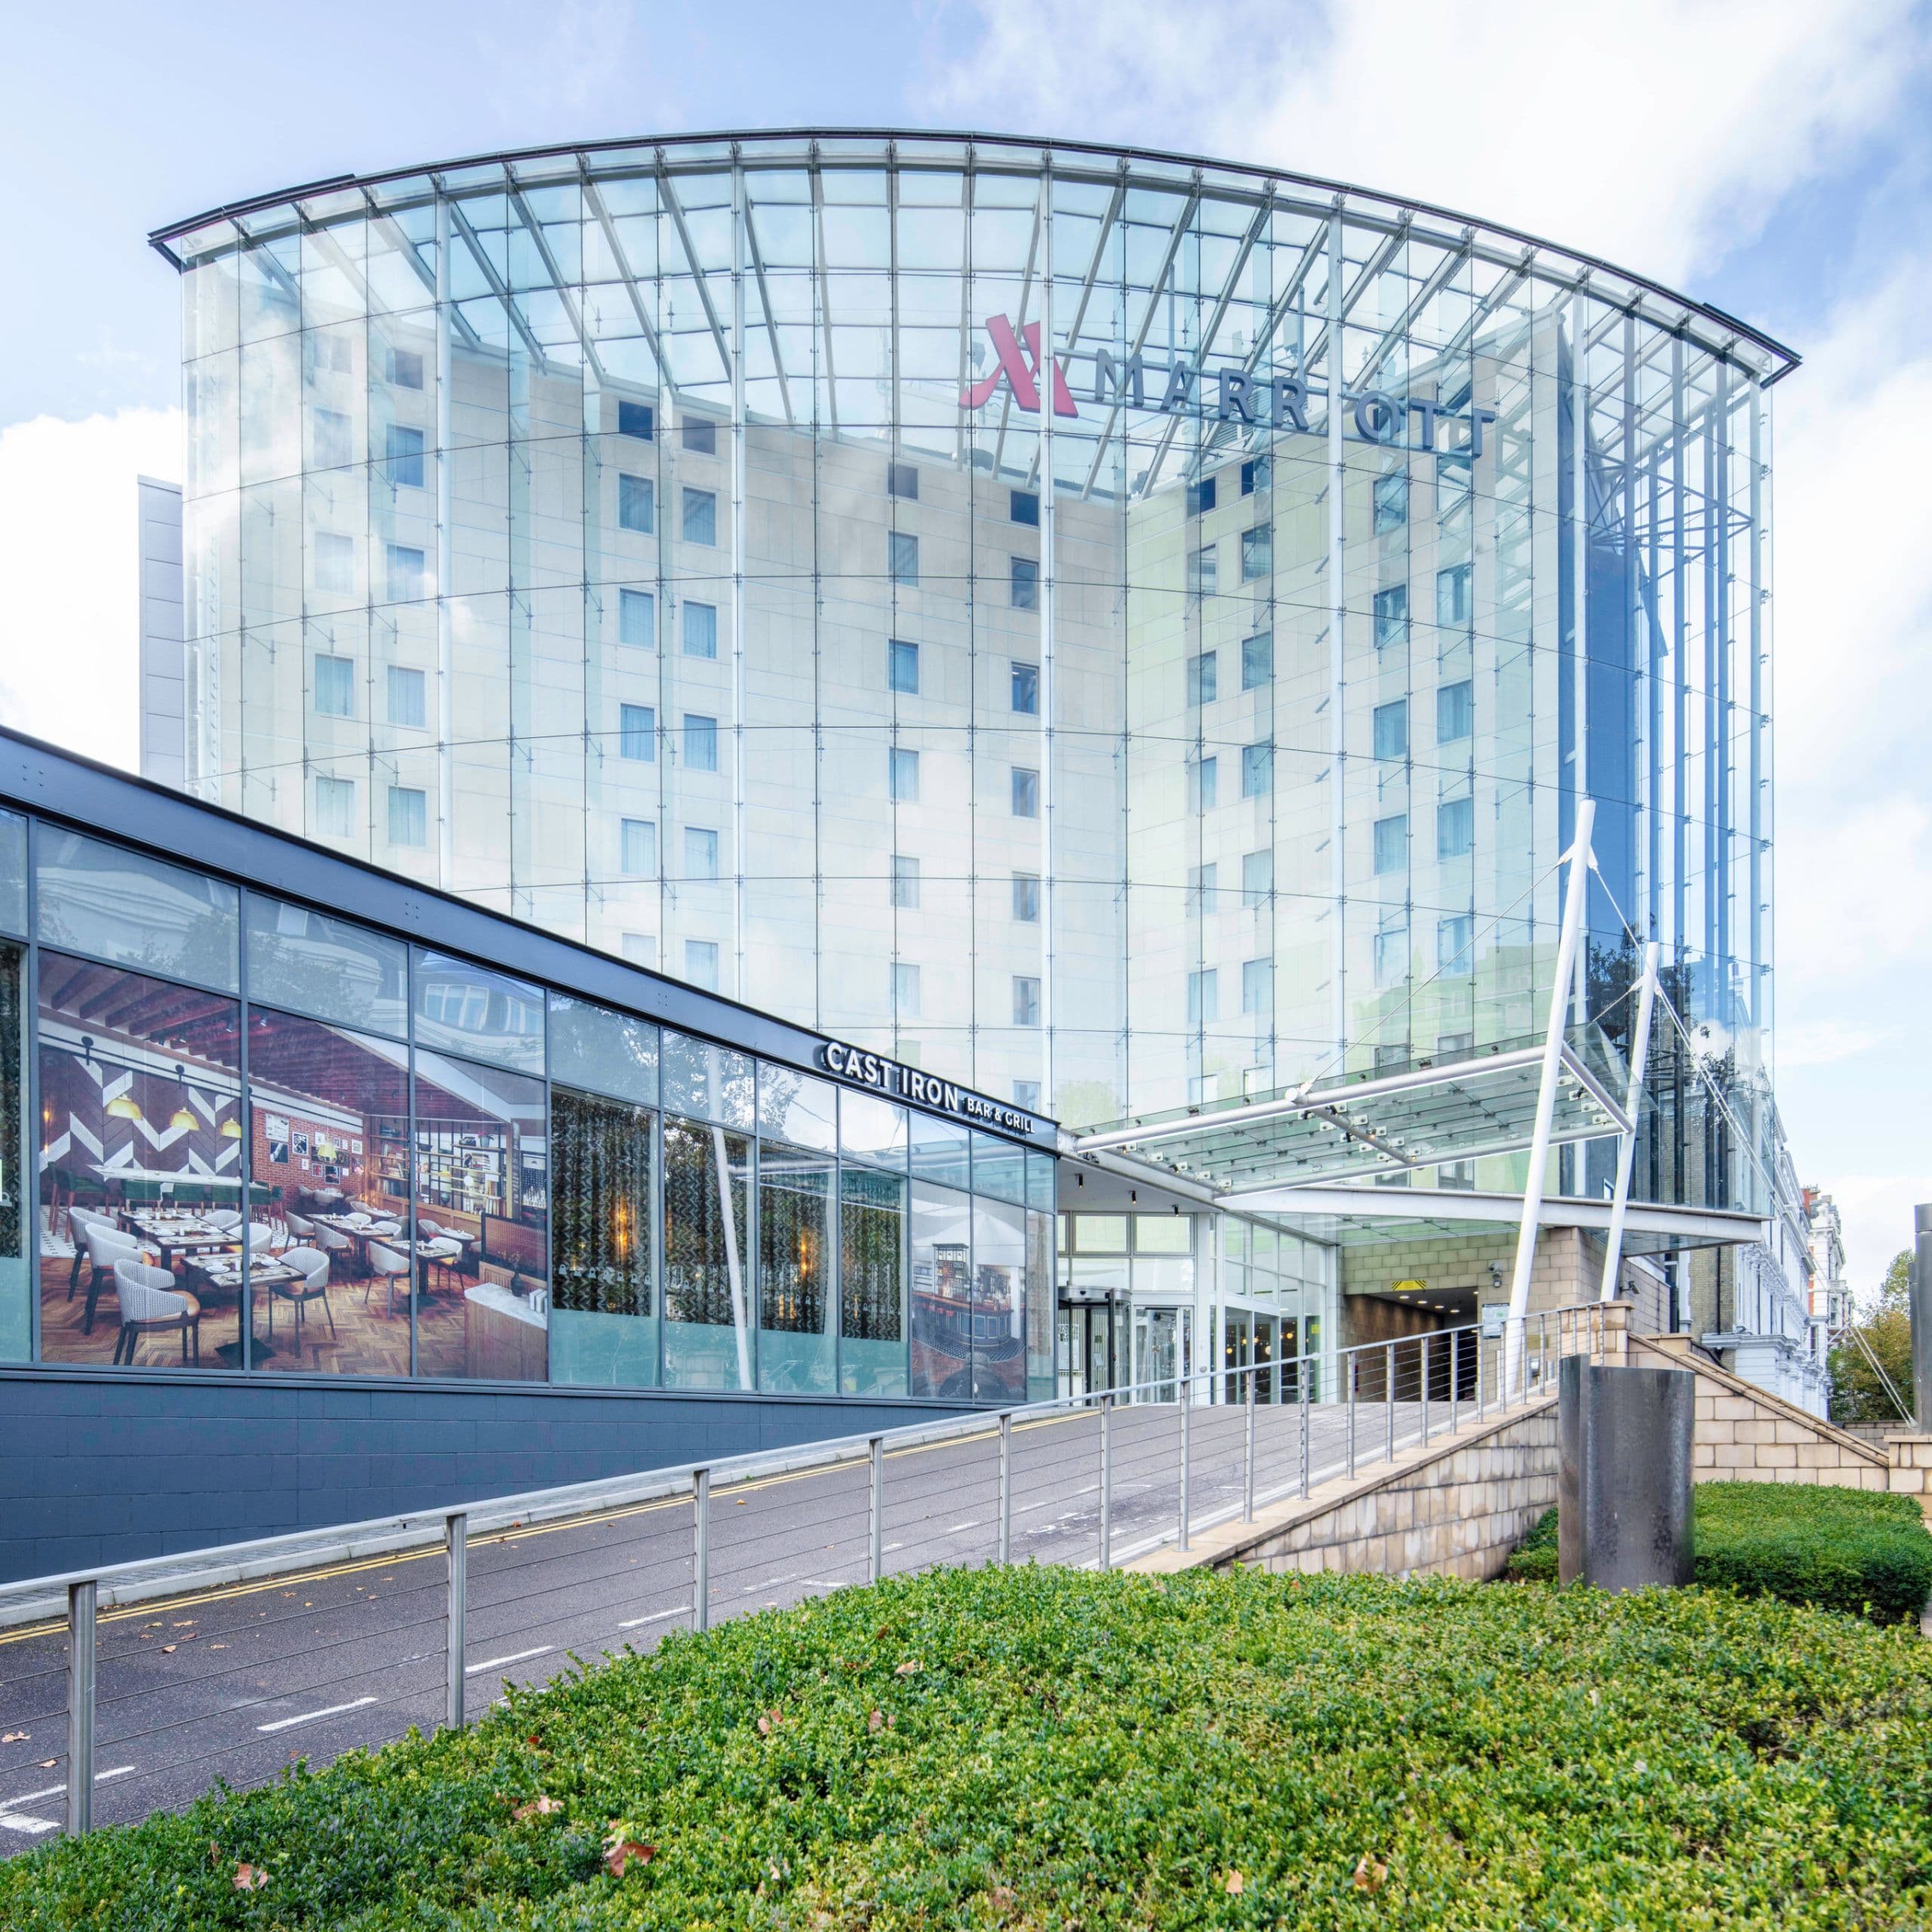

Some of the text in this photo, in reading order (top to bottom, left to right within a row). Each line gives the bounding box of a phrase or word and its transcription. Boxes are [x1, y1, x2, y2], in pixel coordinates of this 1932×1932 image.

[1094, 348, 1496, 458] MARROTT
[826, 1041, 1035, 1134] CAST IRON BAR & GRILL
